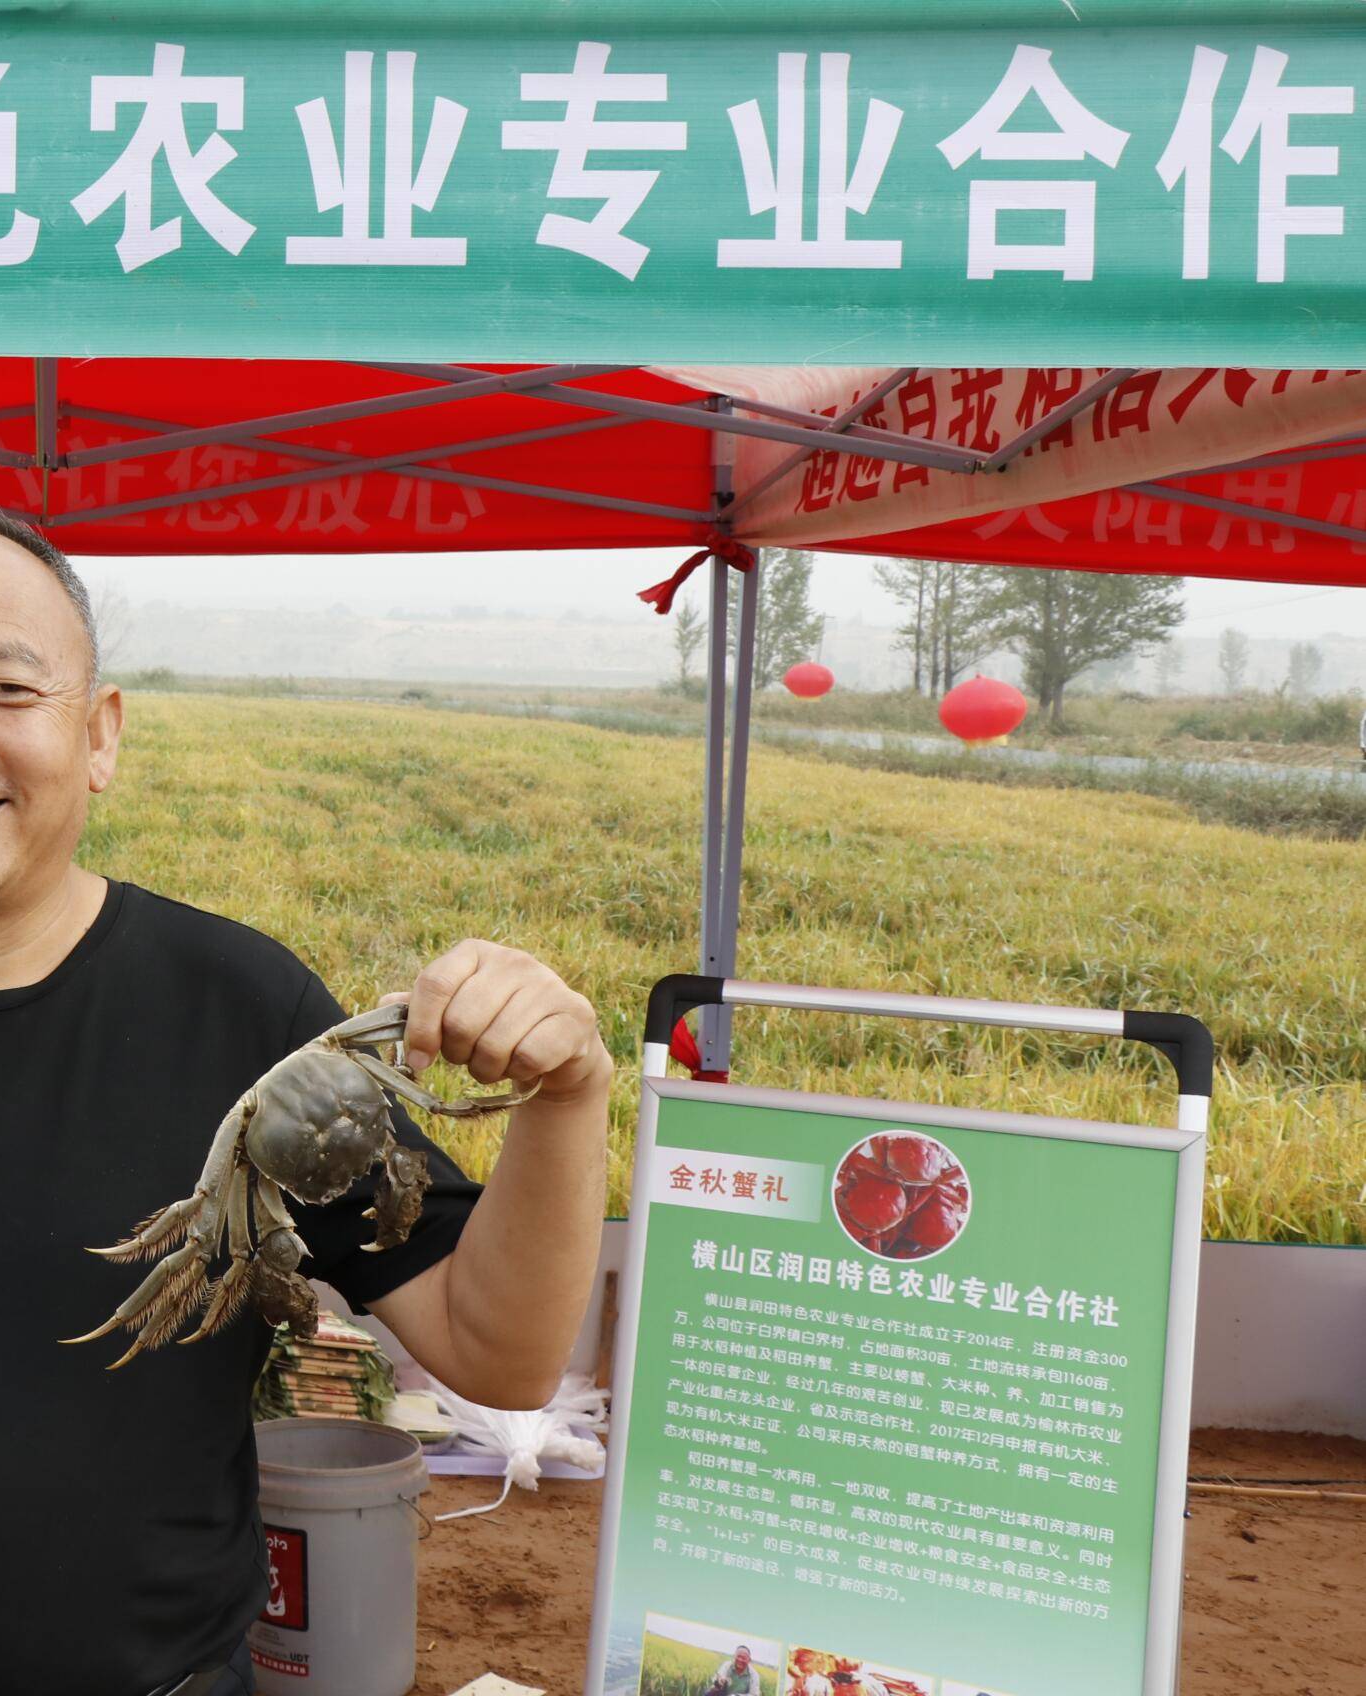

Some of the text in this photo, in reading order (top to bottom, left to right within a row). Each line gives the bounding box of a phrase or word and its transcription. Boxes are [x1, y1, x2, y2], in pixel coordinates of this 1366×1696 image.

[669, 1163, 790, 1203] 金秋蟹礼
[691, 1239, 1120, 1328] 横山区润田特色农业专业合作社
[663, 1423, 769, 1455] 态水稻种养基地。
